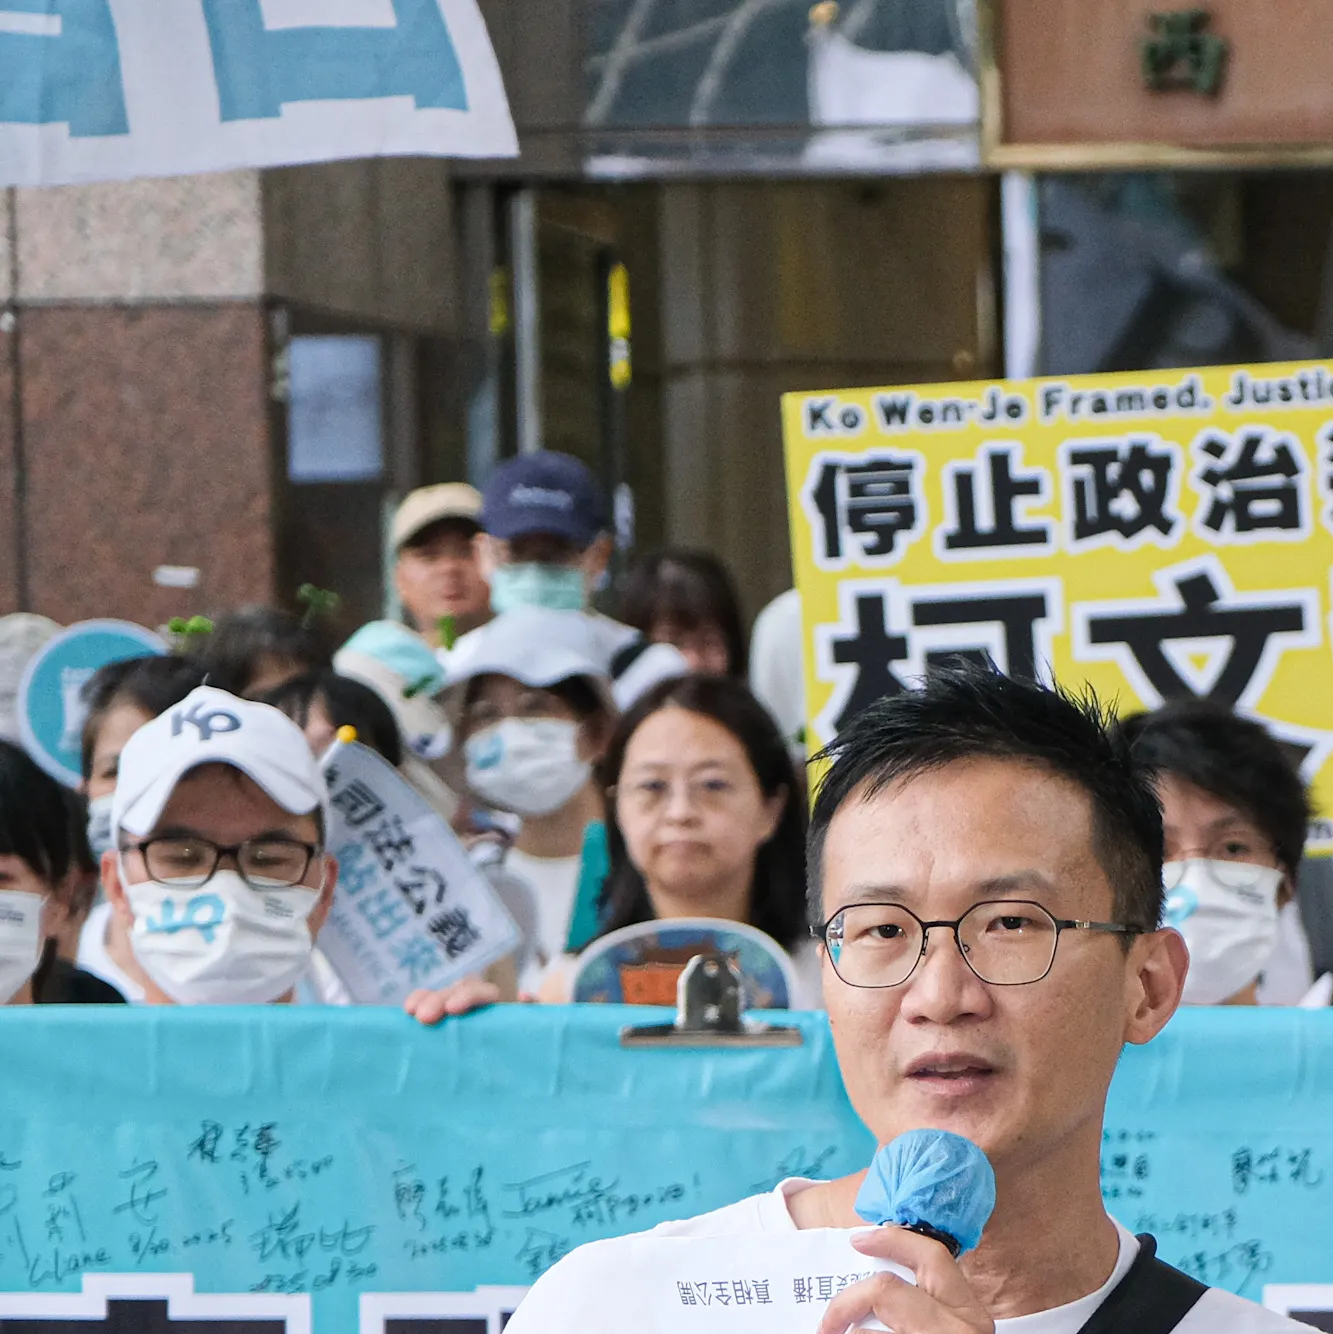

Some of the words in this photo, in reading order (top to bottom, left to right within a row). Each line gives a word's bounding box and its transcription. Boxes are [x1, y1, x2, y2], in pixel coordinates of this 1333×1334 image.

[805, 398, 862, 433] Ko
[877, 390, 1024, 428] Wen-Je
[676, 1278, 773, 1306] 真相全公開
[792, 1271, 877, 1304] 要直播
